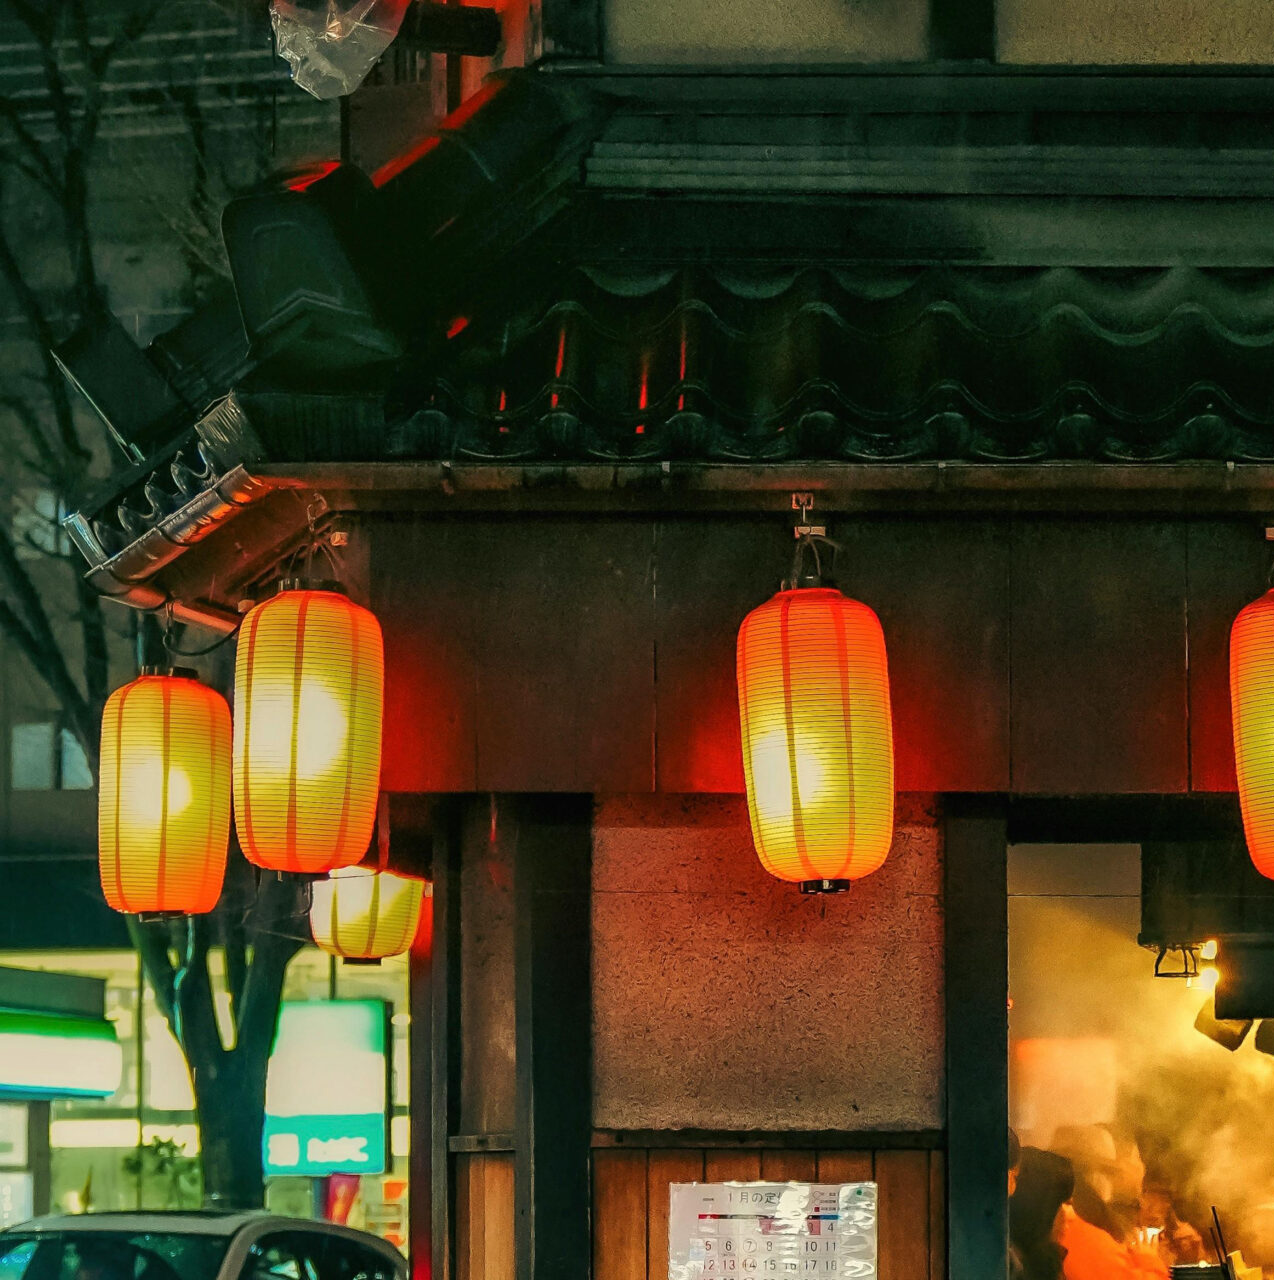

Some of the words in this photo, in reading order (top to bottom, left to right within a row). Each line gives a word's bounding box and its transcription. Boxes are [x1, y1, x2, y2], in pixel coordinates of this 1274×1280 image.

[828, 1222, 834, 1232] 4
[705, 1241, 712, 1251] 5
[726, 1241, 732, 1251] 6
[767, 1241, 772, 1251] 8
[805, 1242, 817, 1252] 10
[826, 1242, 836, 1251] 11
[723, 1260, 735, 1270] 13
[744, 1260, 757, 1270] 14
[764, 1260, 776, 1270] 15
[805, 1260, 817, 1270] 17
[826, 1260, 837, 1270] 18
